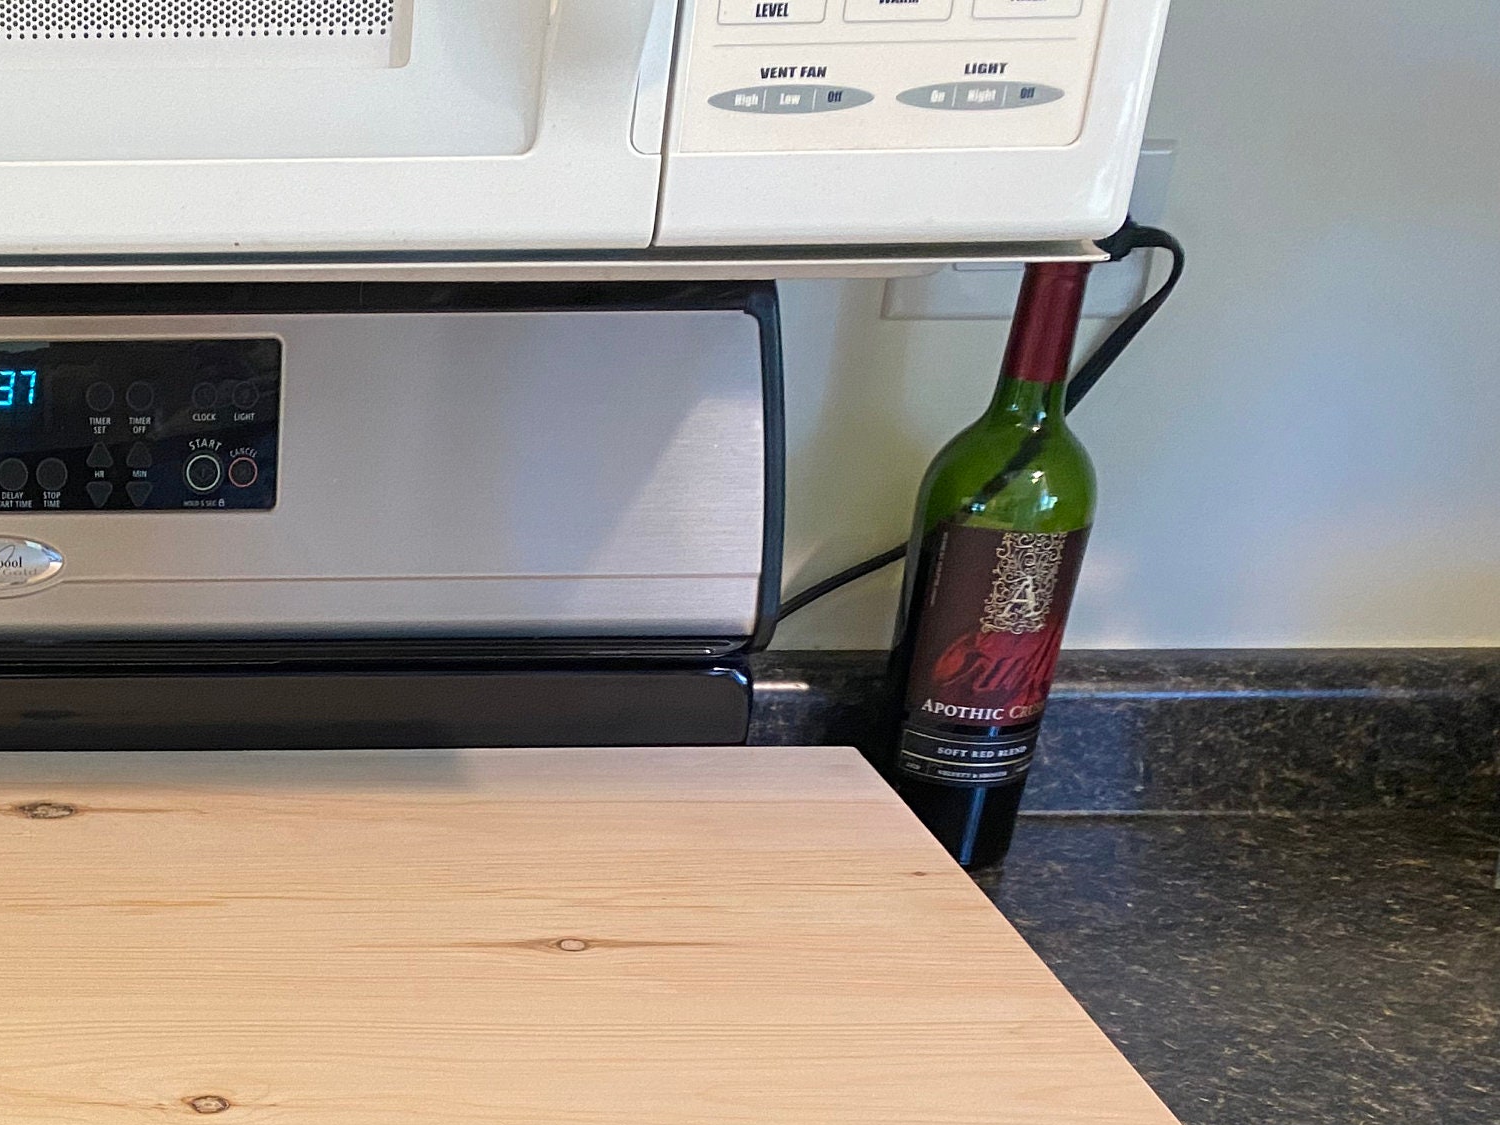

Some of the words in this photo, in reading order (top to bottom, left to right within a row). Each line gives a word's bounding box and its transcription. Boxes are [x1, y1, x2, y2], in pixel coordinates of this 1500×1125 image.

[755, 3, 789, 18] LEVEL
[760, 67, 797, 79] VENT
[800, 66, 827, 79] FAN
[964, 63, 1008, 75] LIGHT
[1020, 88, 1036, 99] Off
[779, 93, 800, 105] Low
[827, 91, 842, 103] Off
[89, 417, 111, 425] TIMER
[129, 417, 151, 425] TIMER
[192, 413, 216, 421] CLOCK
[234, 413, 255, 421] LIGHT
[93, 426, 106, 434] SET
[133, 426, 146, 434] OFF
[189, 438, 222, 451] START
[1, 491, 24, 499] DELAY
[43, 491, 61, 499] STOP
[15, 500, 32, 508] TIME
[43, 500, 60, 508] TIME
[921, 698, 1004, 720] APOTHIC
[938, 747, 968, 757] SOFT
[971, 750, 995, 758] RED
